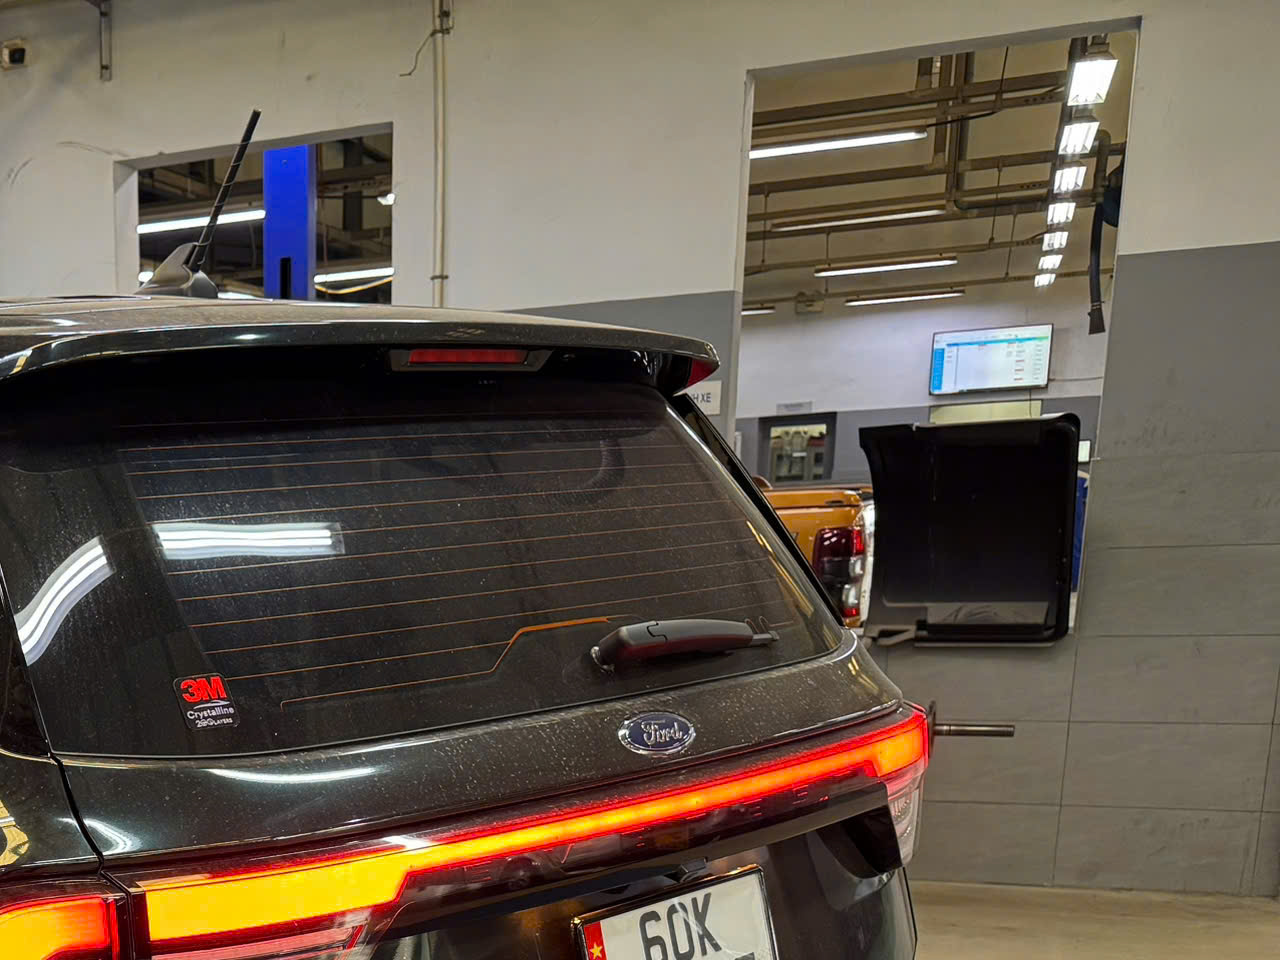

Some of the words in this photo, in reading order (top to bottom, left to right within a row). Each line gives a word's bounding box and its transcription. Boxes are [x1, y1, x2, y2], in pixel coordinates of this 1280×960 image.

[180, 676, 227, 703] 3M
[187, 706, 235, 720] Crystalline
[641, 719, 683, 746] Ford
